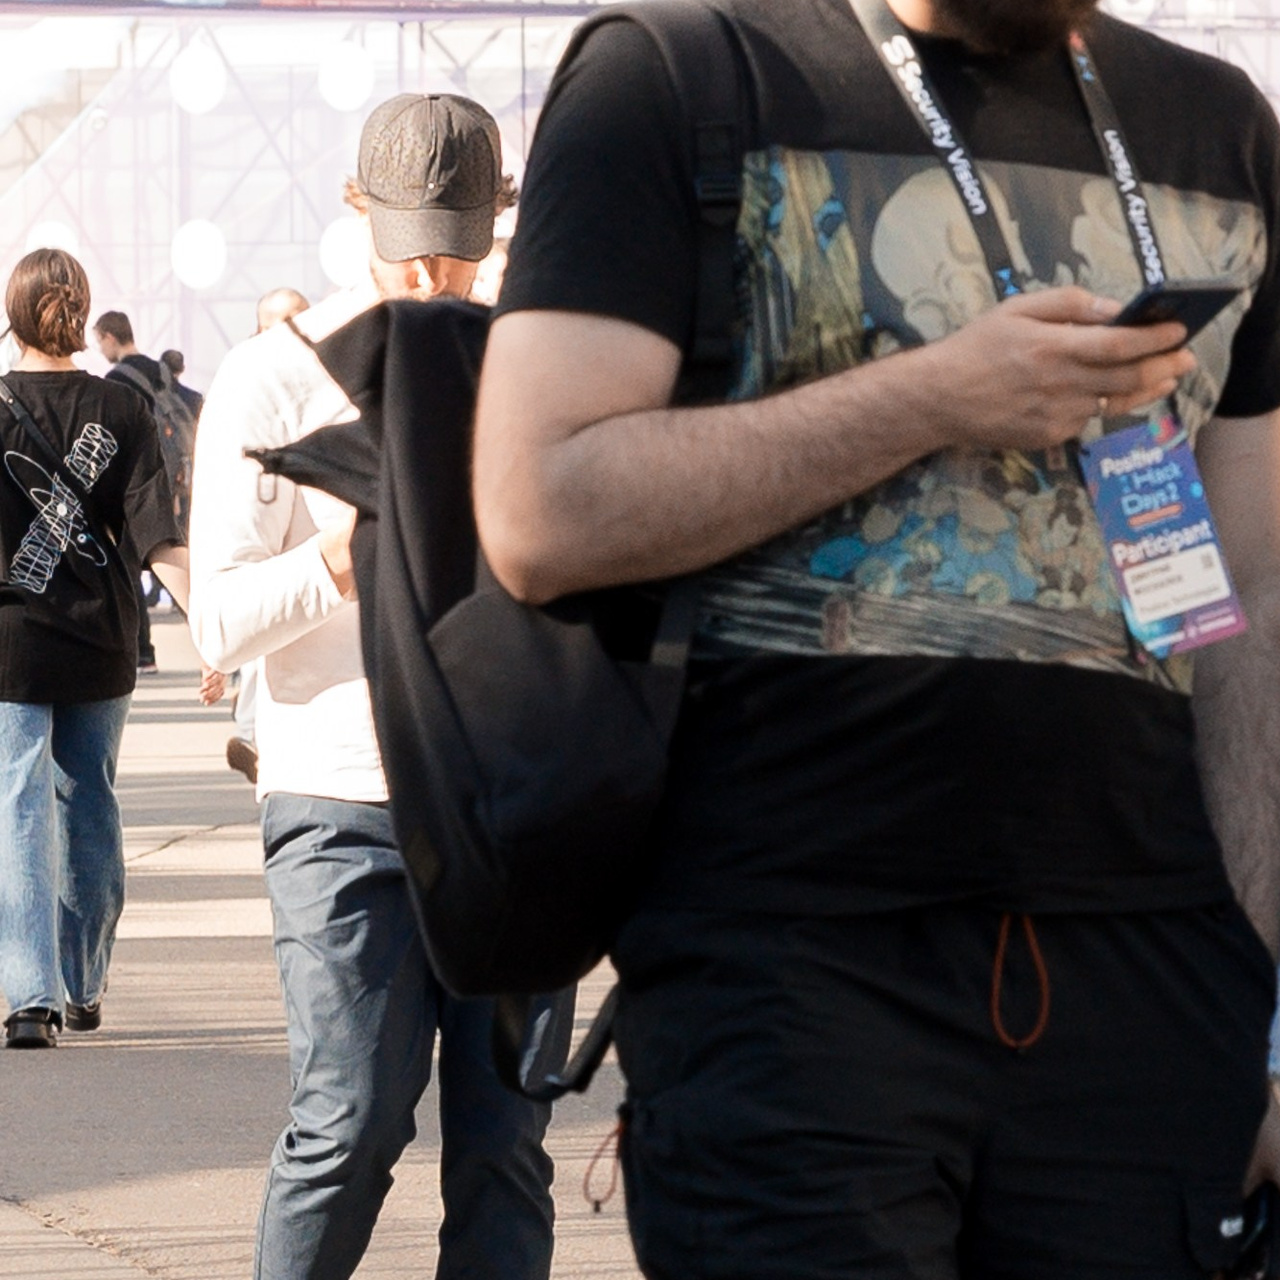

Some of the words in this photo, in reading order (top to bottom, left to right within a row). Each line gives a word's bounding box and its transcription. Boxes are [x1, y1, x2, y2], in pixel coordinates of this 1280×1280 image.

[897, 61, 957, 150] Security
[947, 148, 988, 216] Vision
[1103, 129, 1138, 192] Vision
[1101, 445, 1164, 478] Positive
[1111, 520, 1215, 565] Participant
